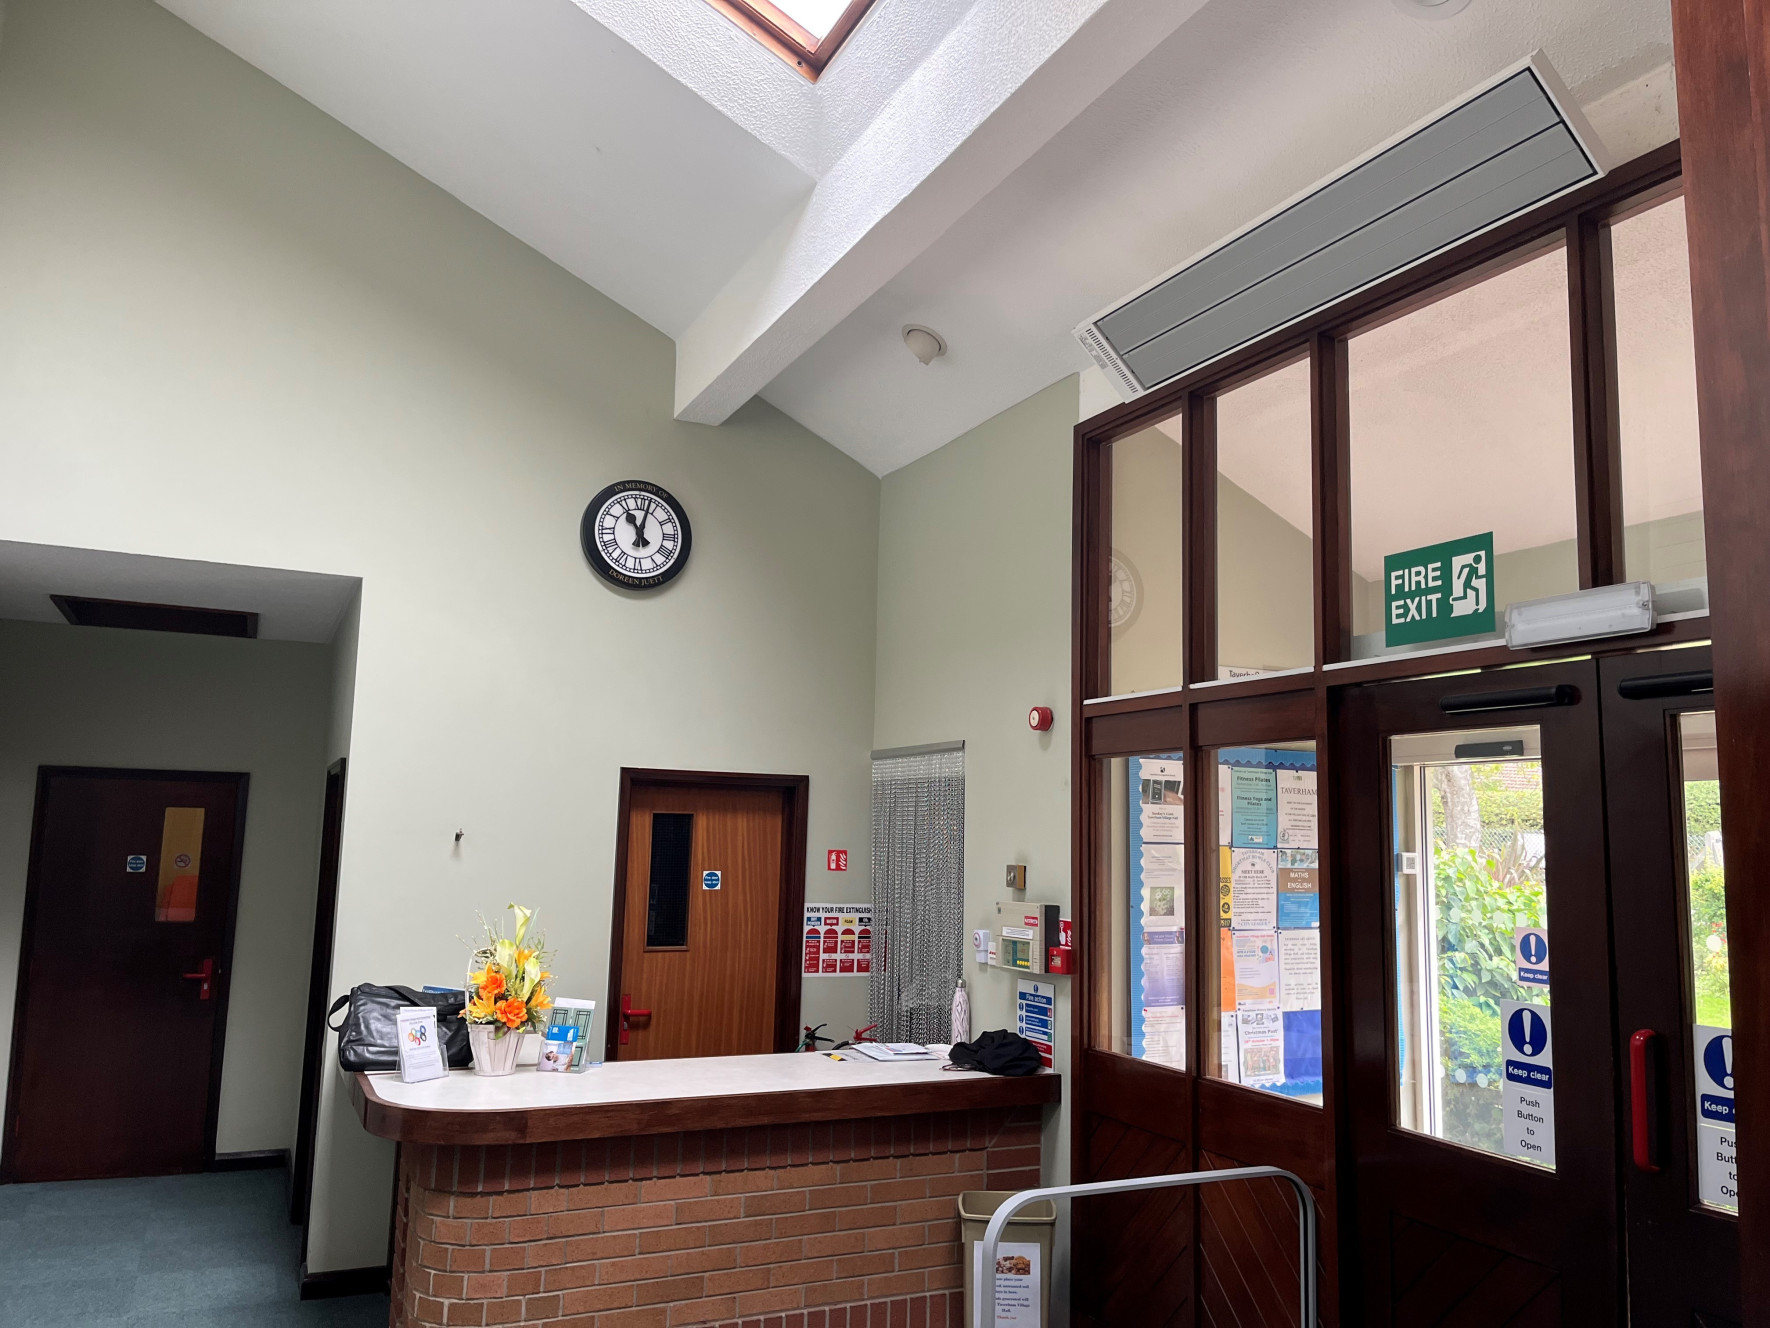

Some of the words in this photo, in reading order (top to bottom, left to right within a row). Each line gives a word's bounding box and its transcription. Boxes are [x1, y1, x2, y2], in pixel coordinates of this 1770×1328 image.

[614, 484, 624, 492] IN
[625, 482, 656, 492] MEMORY
[658, 490, 668, 499] OF
[608, 569, 639, 584] DOREEN
[641, 575, 663, 586] JUETT
[1391, 562, 1442, 594] FIRE
[1391, 593, 1442, 624] EXIT
[1228, 670, 1260, 678] Taverh
[1520, 971, 1534, 979] Keep
[1026, 994, 1034, 1002] Fire
[1508, 1066, 1528, 1078] Keep
[1530, 1071, 1549, 1081] clear
[1520, 1096, 1540, 1108] Push
[1704, 1101, 1729, 1114] Keep
[1517, 1109, 1544, 1124] Button
[1526, 1127, 1535, 1136] to
[1520, 1139, 1542, 1152] Open
